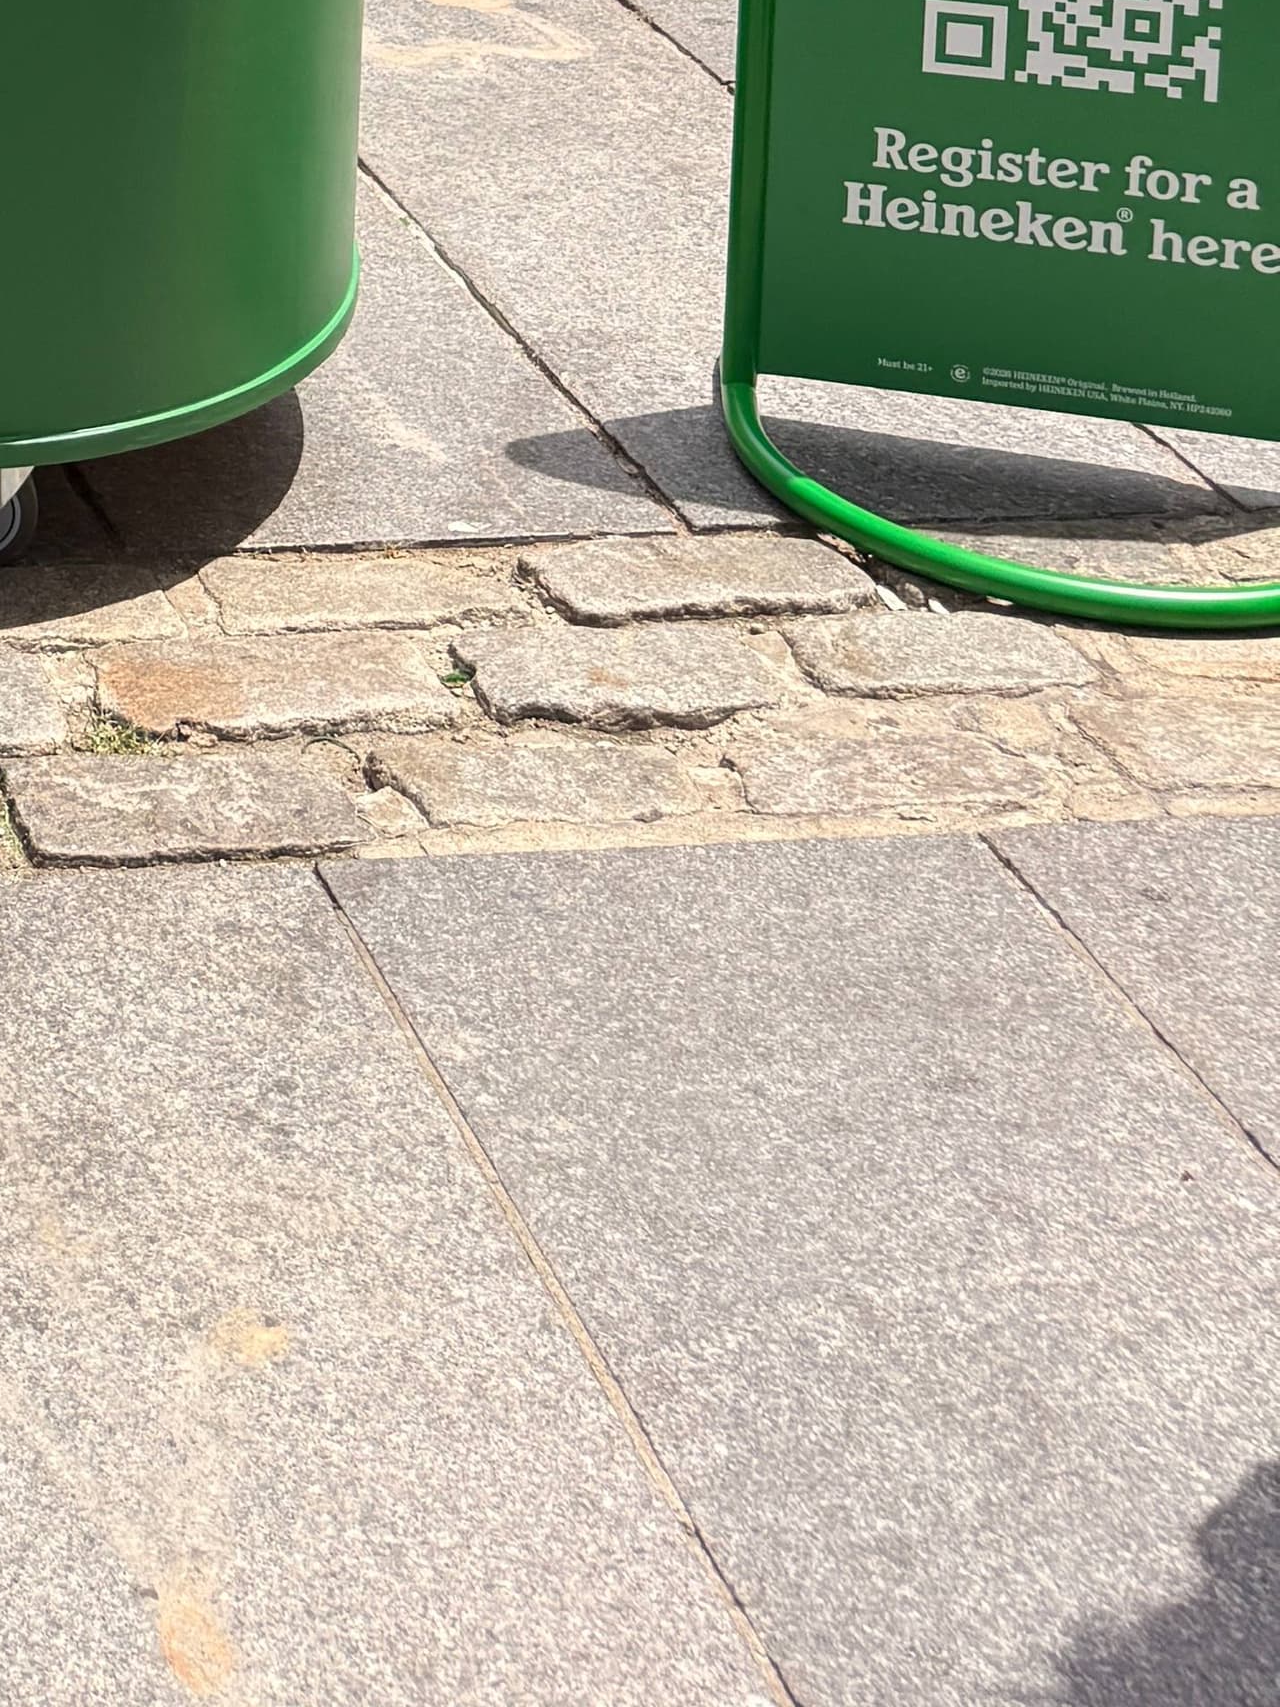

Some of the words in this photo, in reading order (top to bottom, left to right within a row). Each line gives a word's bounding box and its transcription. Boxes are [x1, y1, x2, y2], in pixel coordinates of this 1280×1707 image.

[872, 126, 1110, 193] Register
[1123, 154, 1213, 204] for
[1225, 175, 1261, 211] a
[1147, 218, 1280, 275] here
[877, 357, 901, 369] Must
[903, 361, 915, 371] be
[916, 362, 933, 372] 21+
[982, 376, 1025, 389] Imported
[1026, 381, 1037, 393] by
[1147, 387, 1158, 398] in
